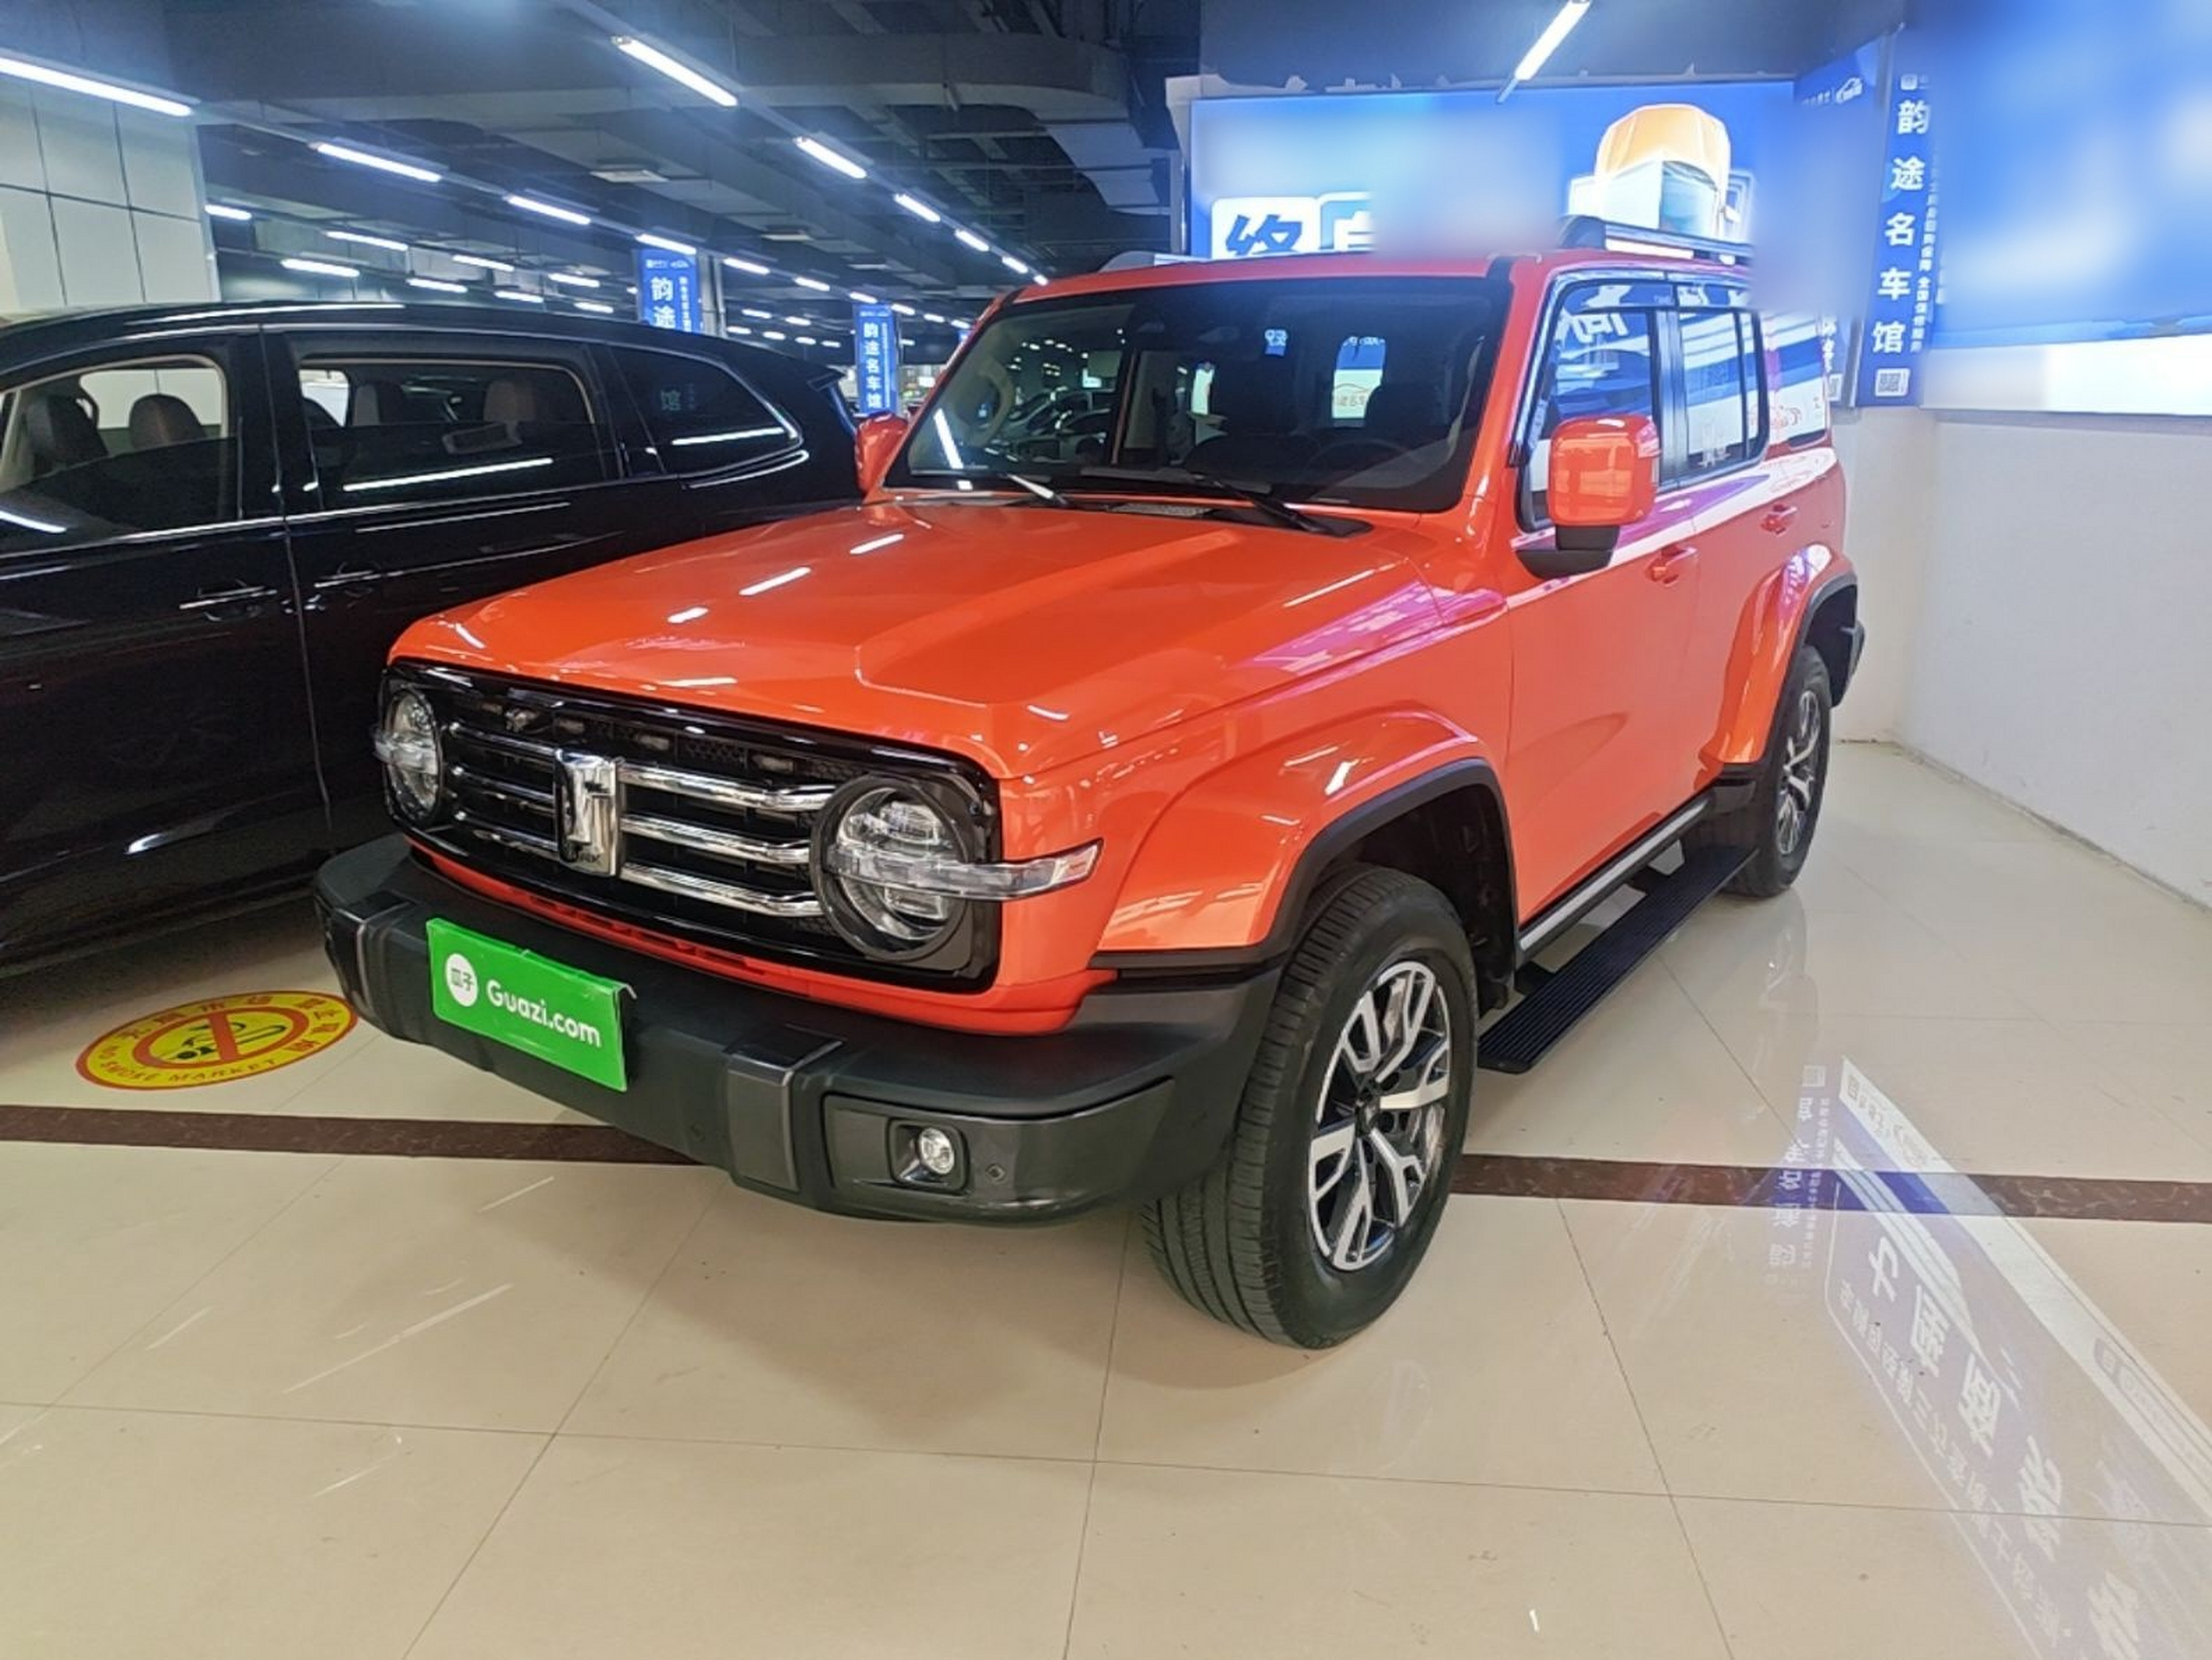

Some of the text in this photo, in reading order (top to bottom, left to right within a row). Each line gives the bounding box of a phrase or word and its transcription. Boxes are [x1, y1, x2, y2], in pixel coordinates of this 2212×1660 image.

[1871, 100, 1930, 354] 韵途名车馆
[487, 980, 601, 1048] Guazi.com
